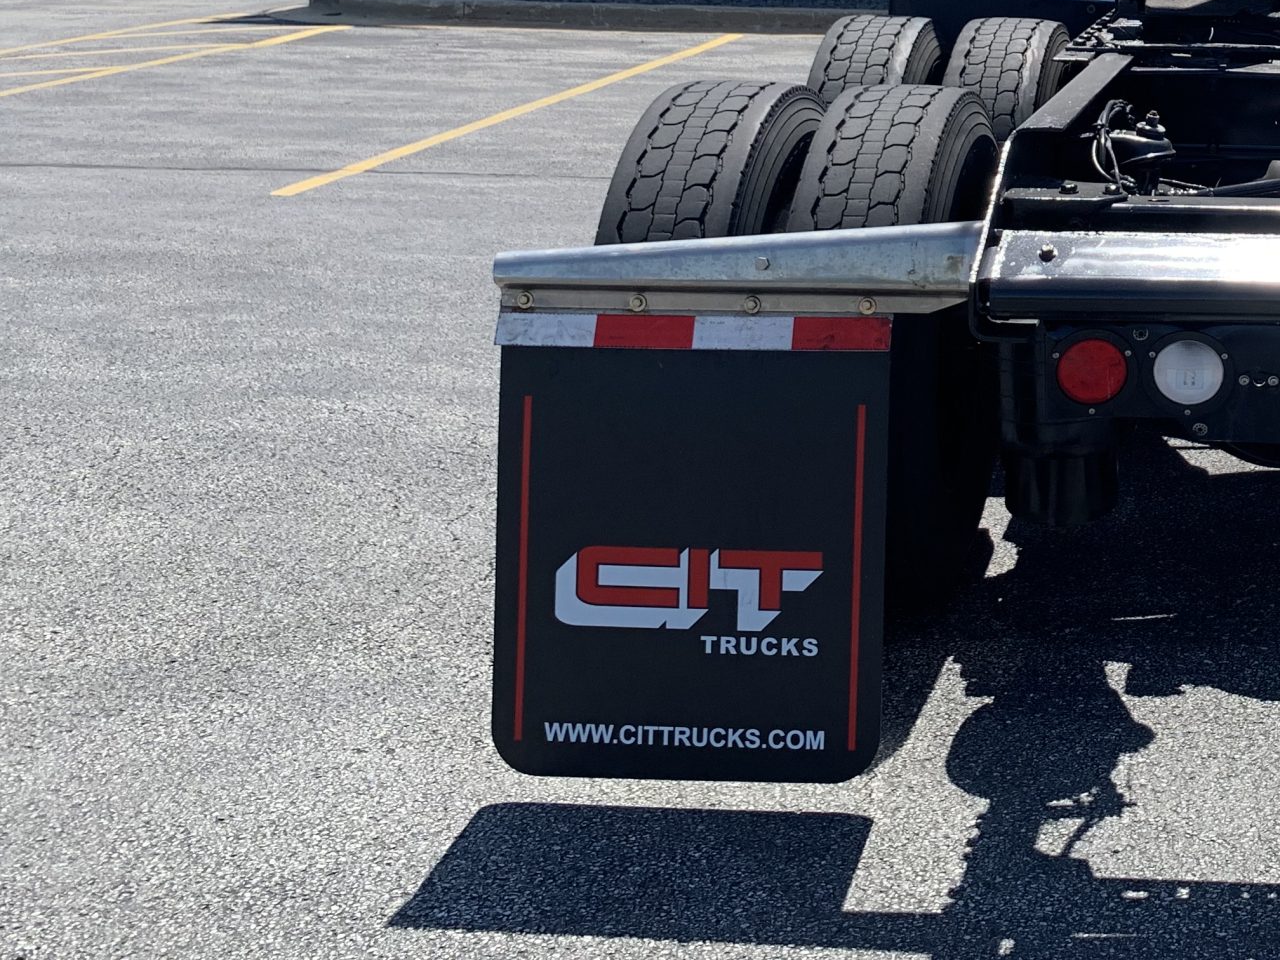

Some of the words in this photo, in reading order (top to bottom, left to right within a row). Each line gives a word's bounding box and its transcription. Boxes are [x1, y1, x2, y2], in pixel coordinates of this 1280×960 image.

[555, 546, 824, 632] CIT
[700, 635, 819, 657] TRUCKS
[544, 722, 825, 750] WWW.CITTRUCKS.COM
